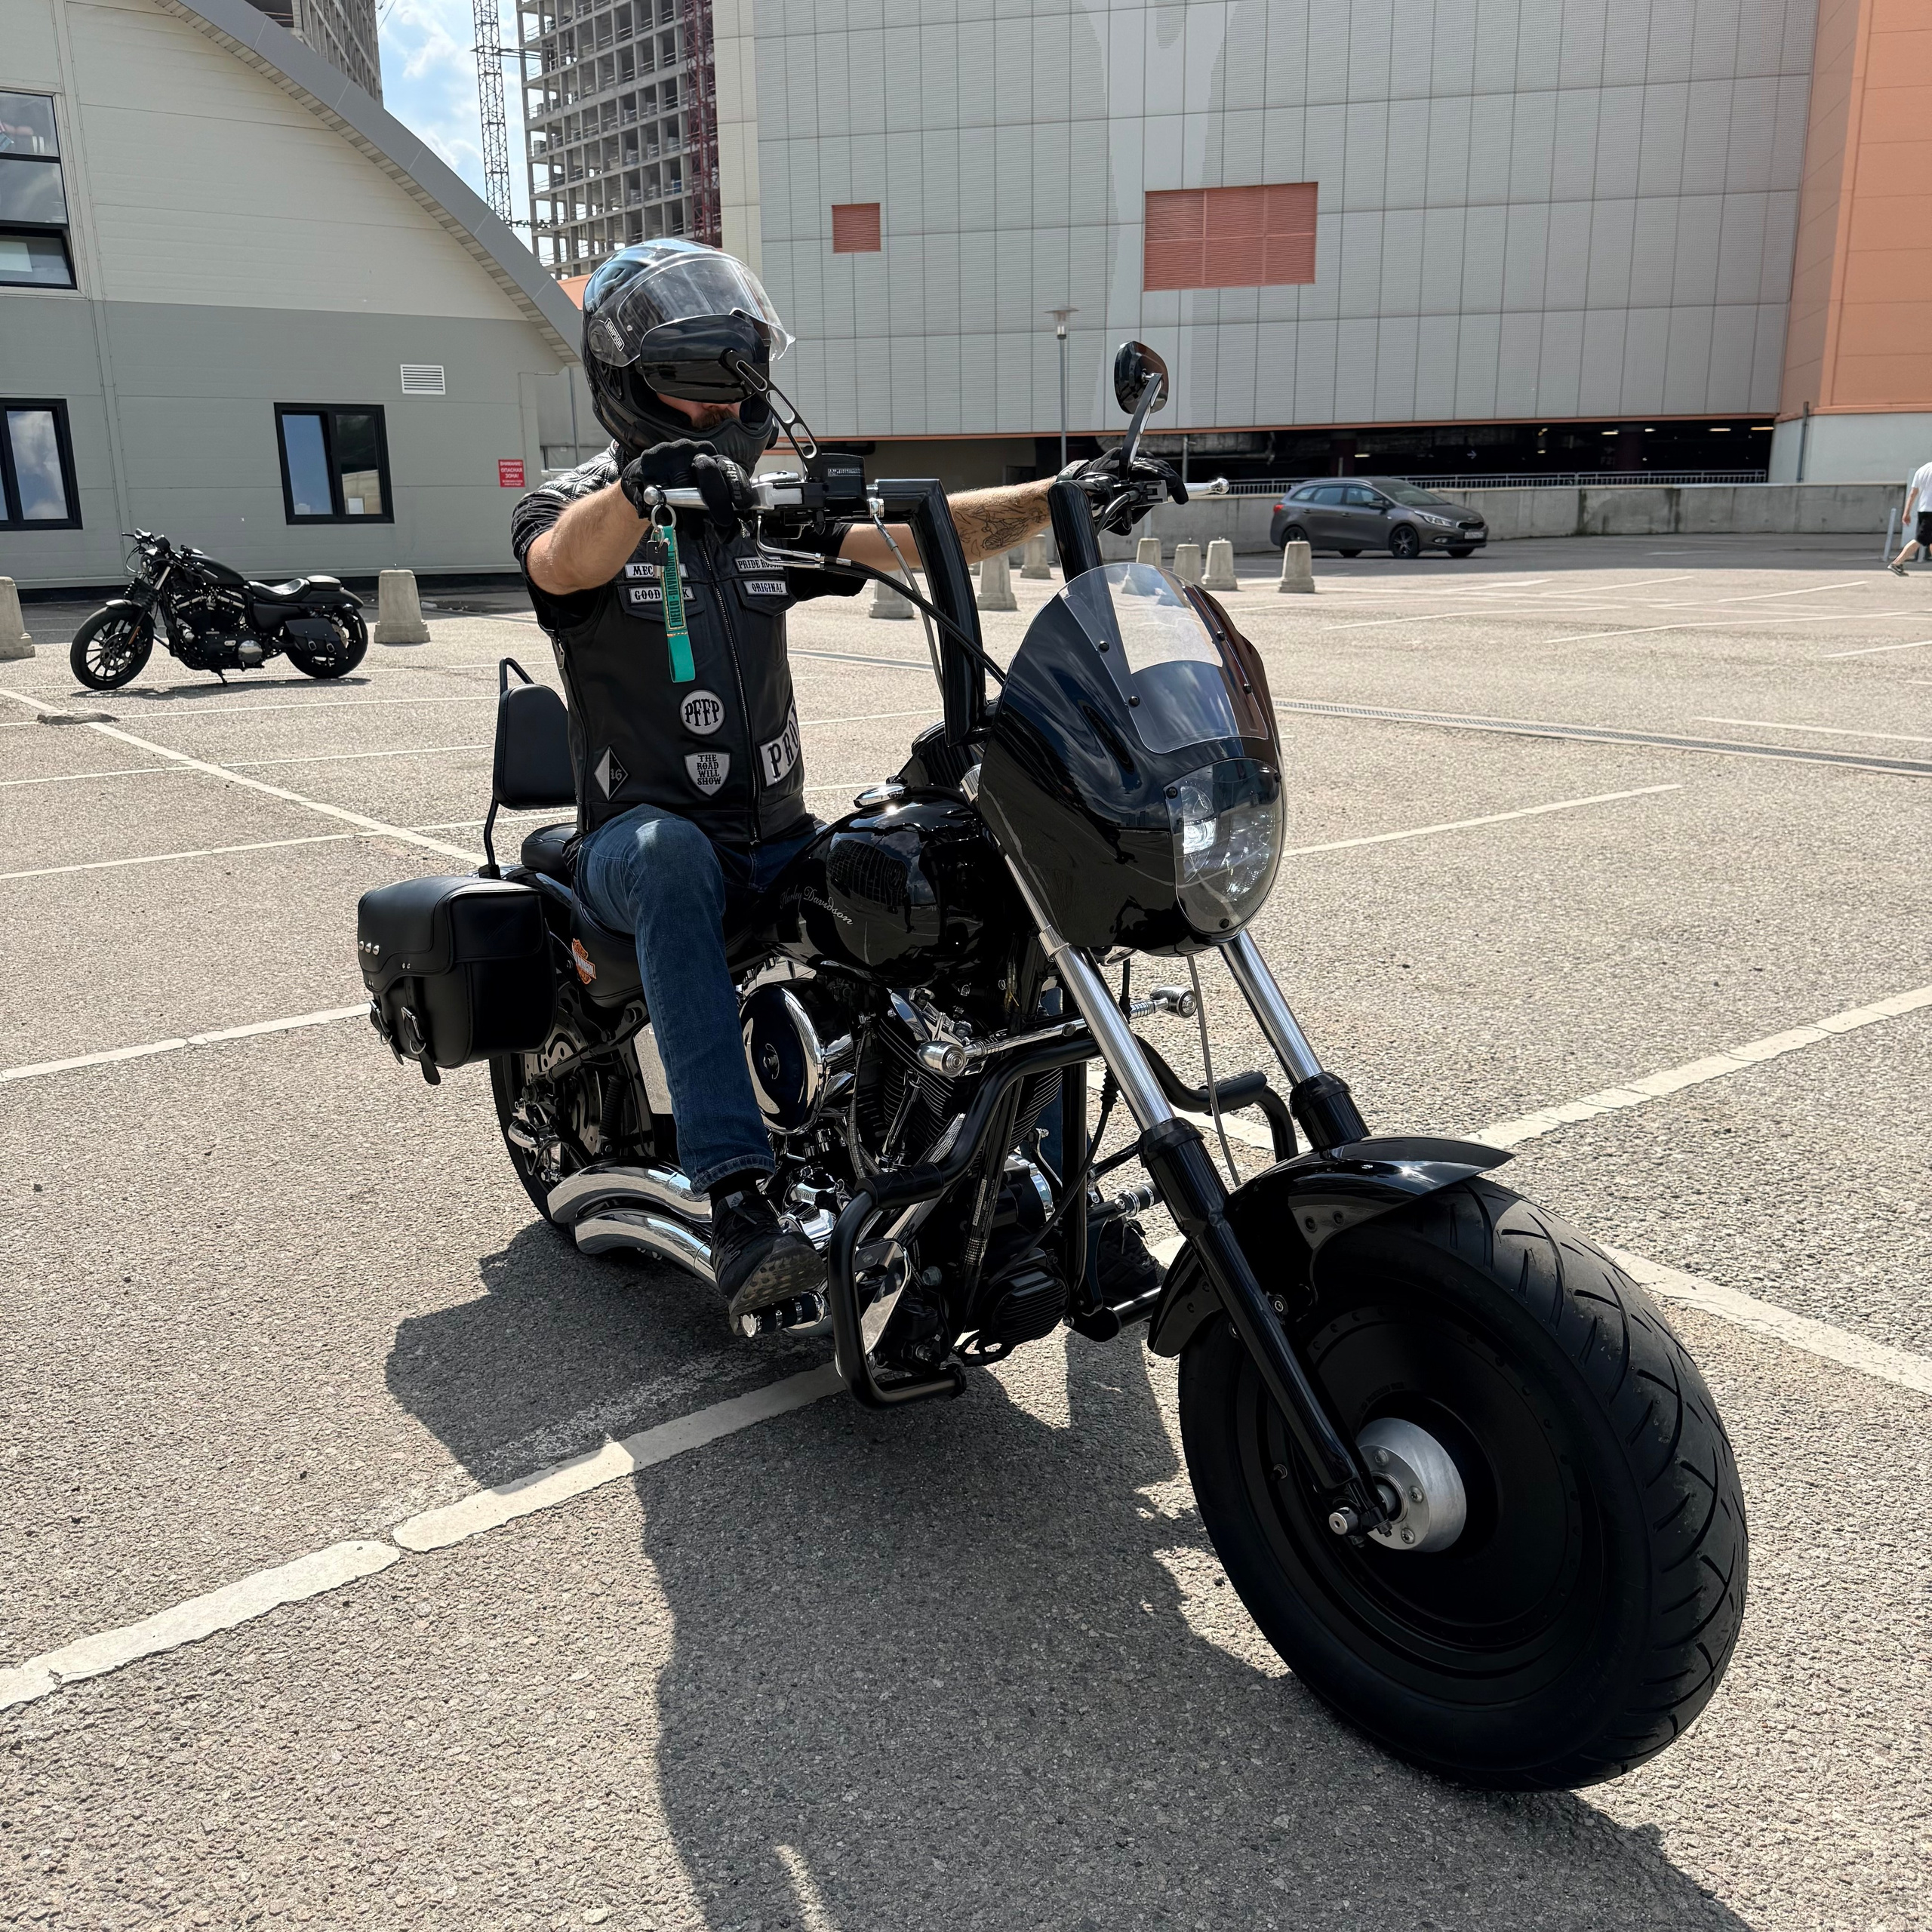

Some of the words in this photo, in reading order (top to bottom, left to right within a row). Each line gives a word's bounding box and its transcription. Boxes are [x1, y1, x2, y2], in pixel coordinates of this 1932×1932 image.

[605, 321, 623, 348] SIMPSON
[737, 559, 761, 569] PRIDE
[751, 583, 783, 593] ORIGINAL
[634, 589, 661, 600] GOOD
[698, 770, 720, 778] WILL
[697, 777, 721, 786] SHOW
[803, 886, 854, 925] Davidson
